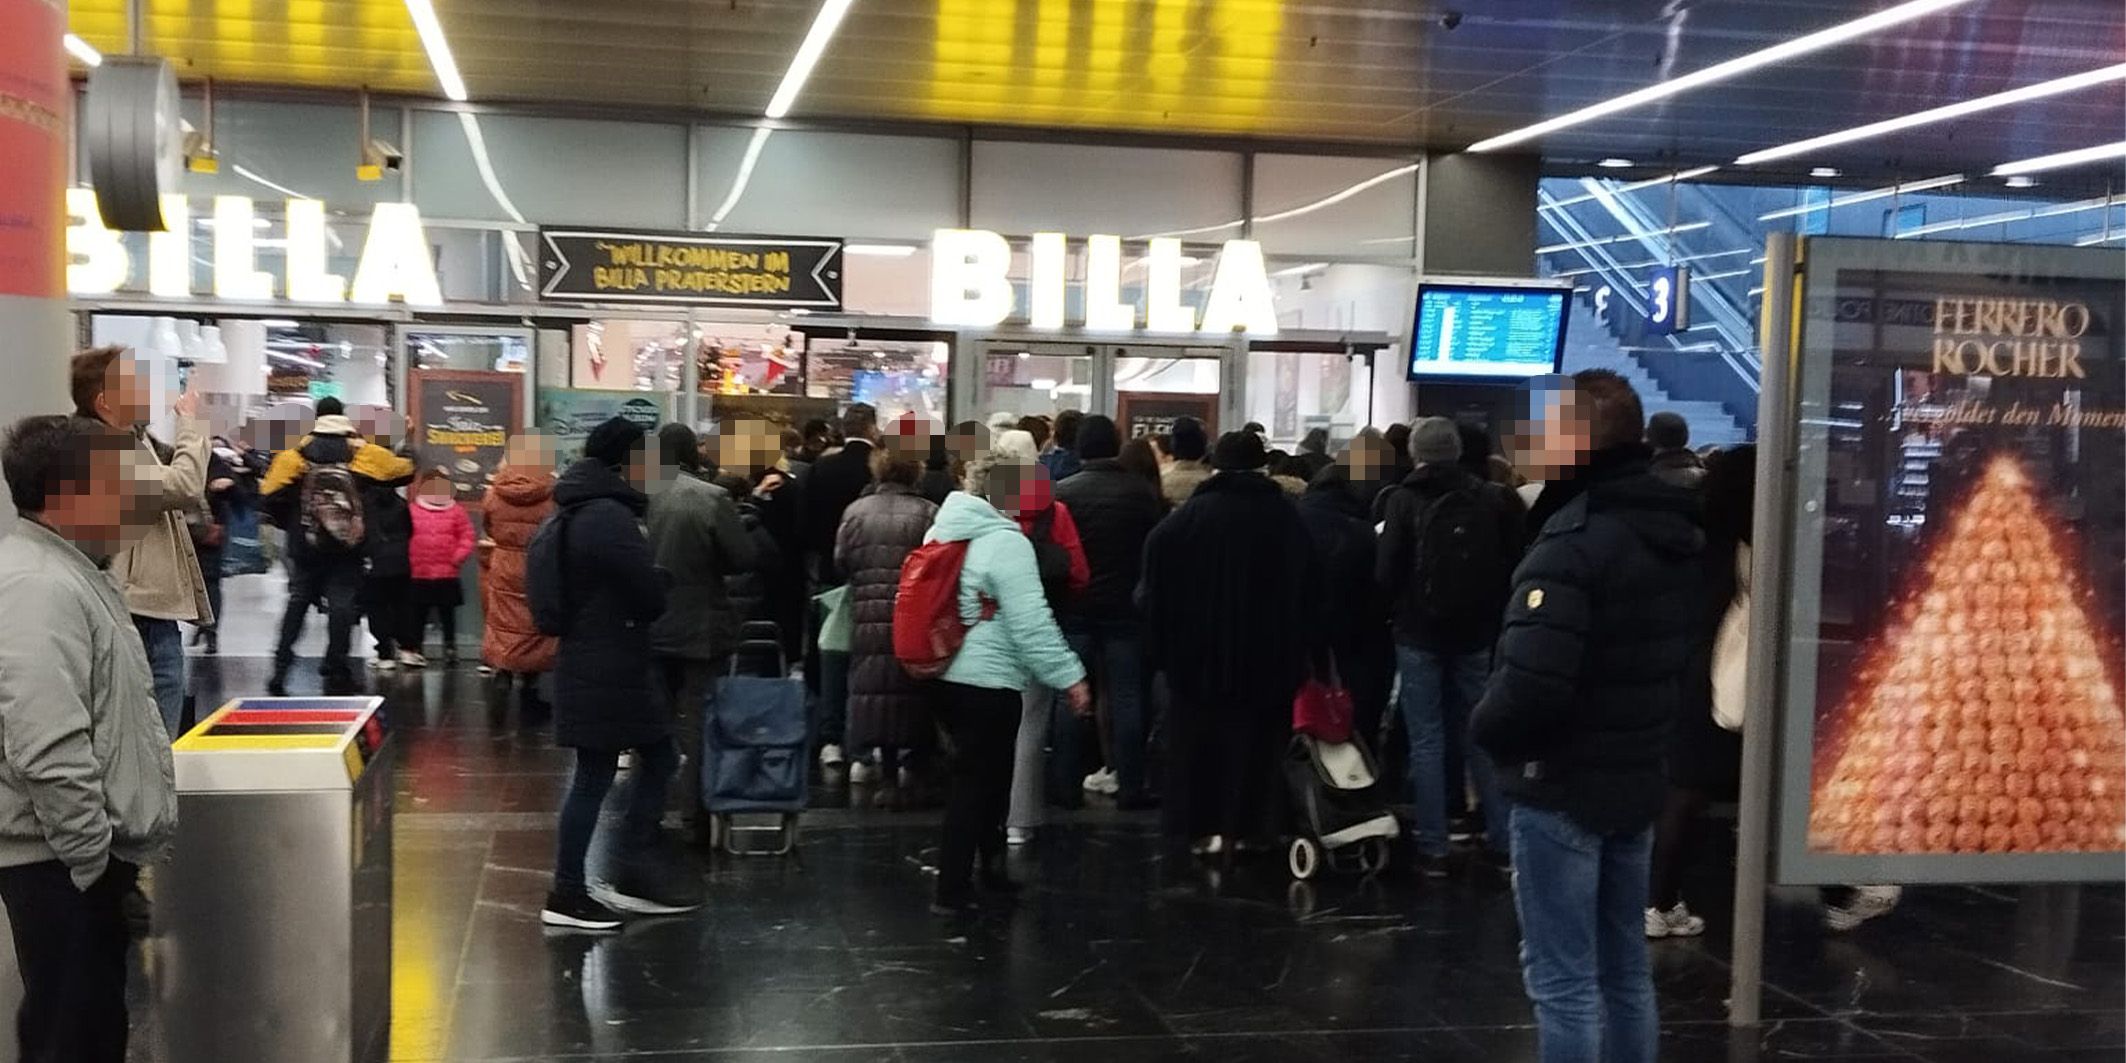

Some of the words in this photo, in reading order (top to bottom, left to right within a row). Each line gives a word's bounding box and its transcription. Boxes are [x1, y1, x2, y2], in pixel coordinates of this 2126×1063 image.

[66, 188, 443, 306] BILLA
[605, 242, 759, 270] WILLKOMMEN
[763, 250, 789, 273] IM
[593, 266, 649, 290] BILLA
[654, 269, 791, 295] PRATERSTERN
[931, 228, 1279, 335] BILLA
[1652, 276, 1669, 323] 3
[1933, 297, 2091, 340] FERRERO
[1932, 338, 2086, 379] ROCHER
[2001, 401, 2040, 425] den
